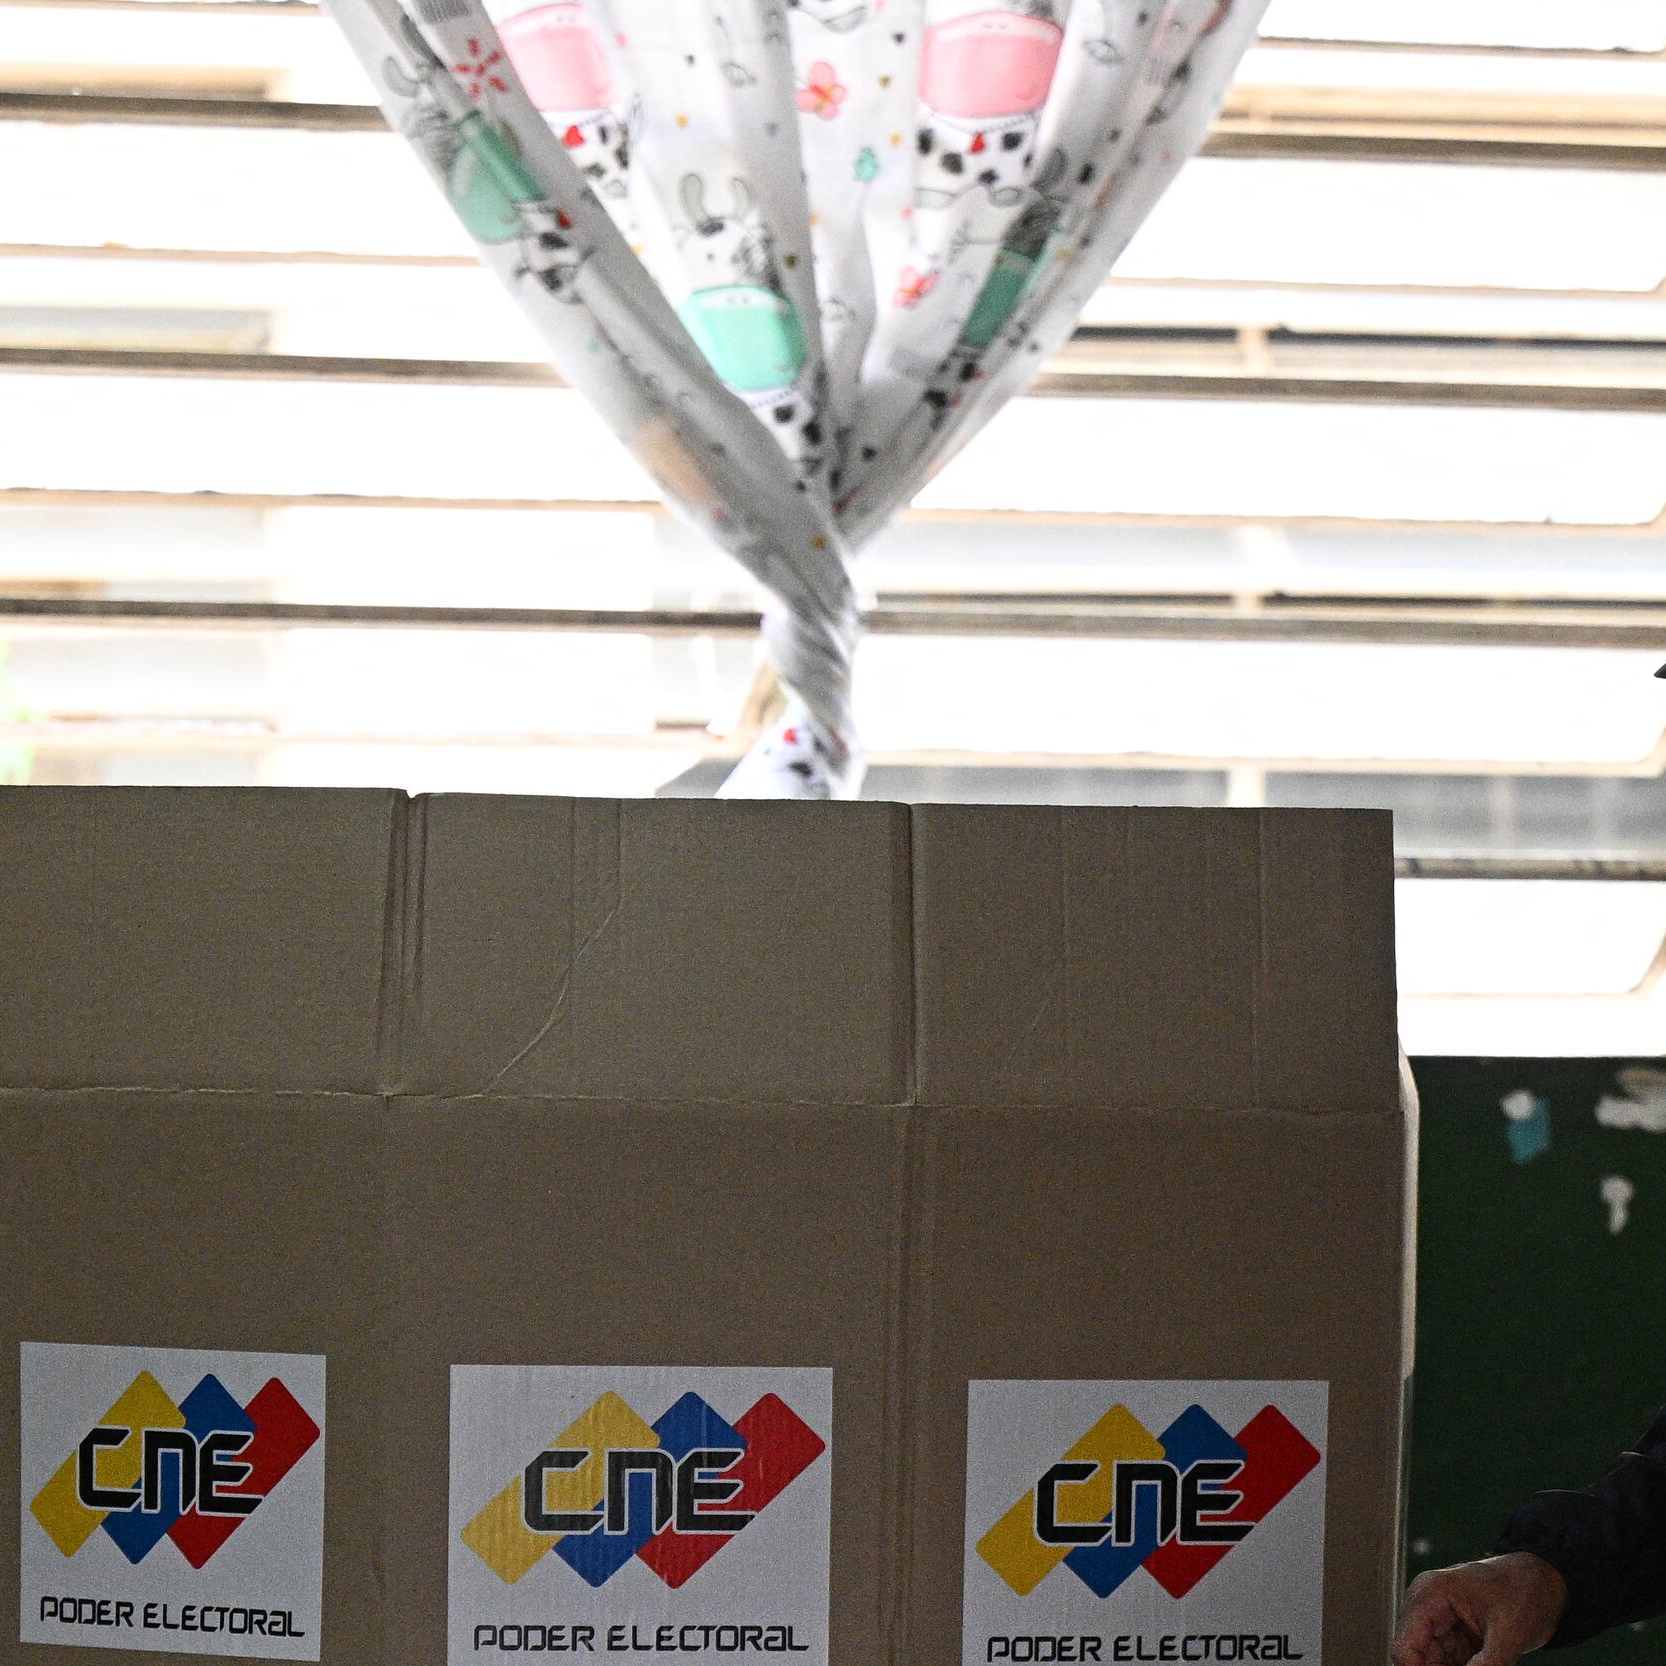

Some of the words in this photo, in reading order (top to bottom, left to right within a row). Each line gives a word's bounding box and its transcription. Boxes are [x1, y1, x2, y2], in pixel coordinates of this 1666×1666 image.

[79, 1427, 264, 1515] CNE
[524, 1450, 757, 1533] CNE
[1036, 1463, 1256, 1544] CNE
[40, 1596, 134, 1627] PODER
[142, 1602, 306, 1638] ELECTORAL
[473, 1624, 596, 1652] PODER
[606, 1624, 810, 1652] ELECTORAL
[986, 1635, 1102, 1663] PODER
[1112, 1634, 1305, 1662] ELECTORAL
